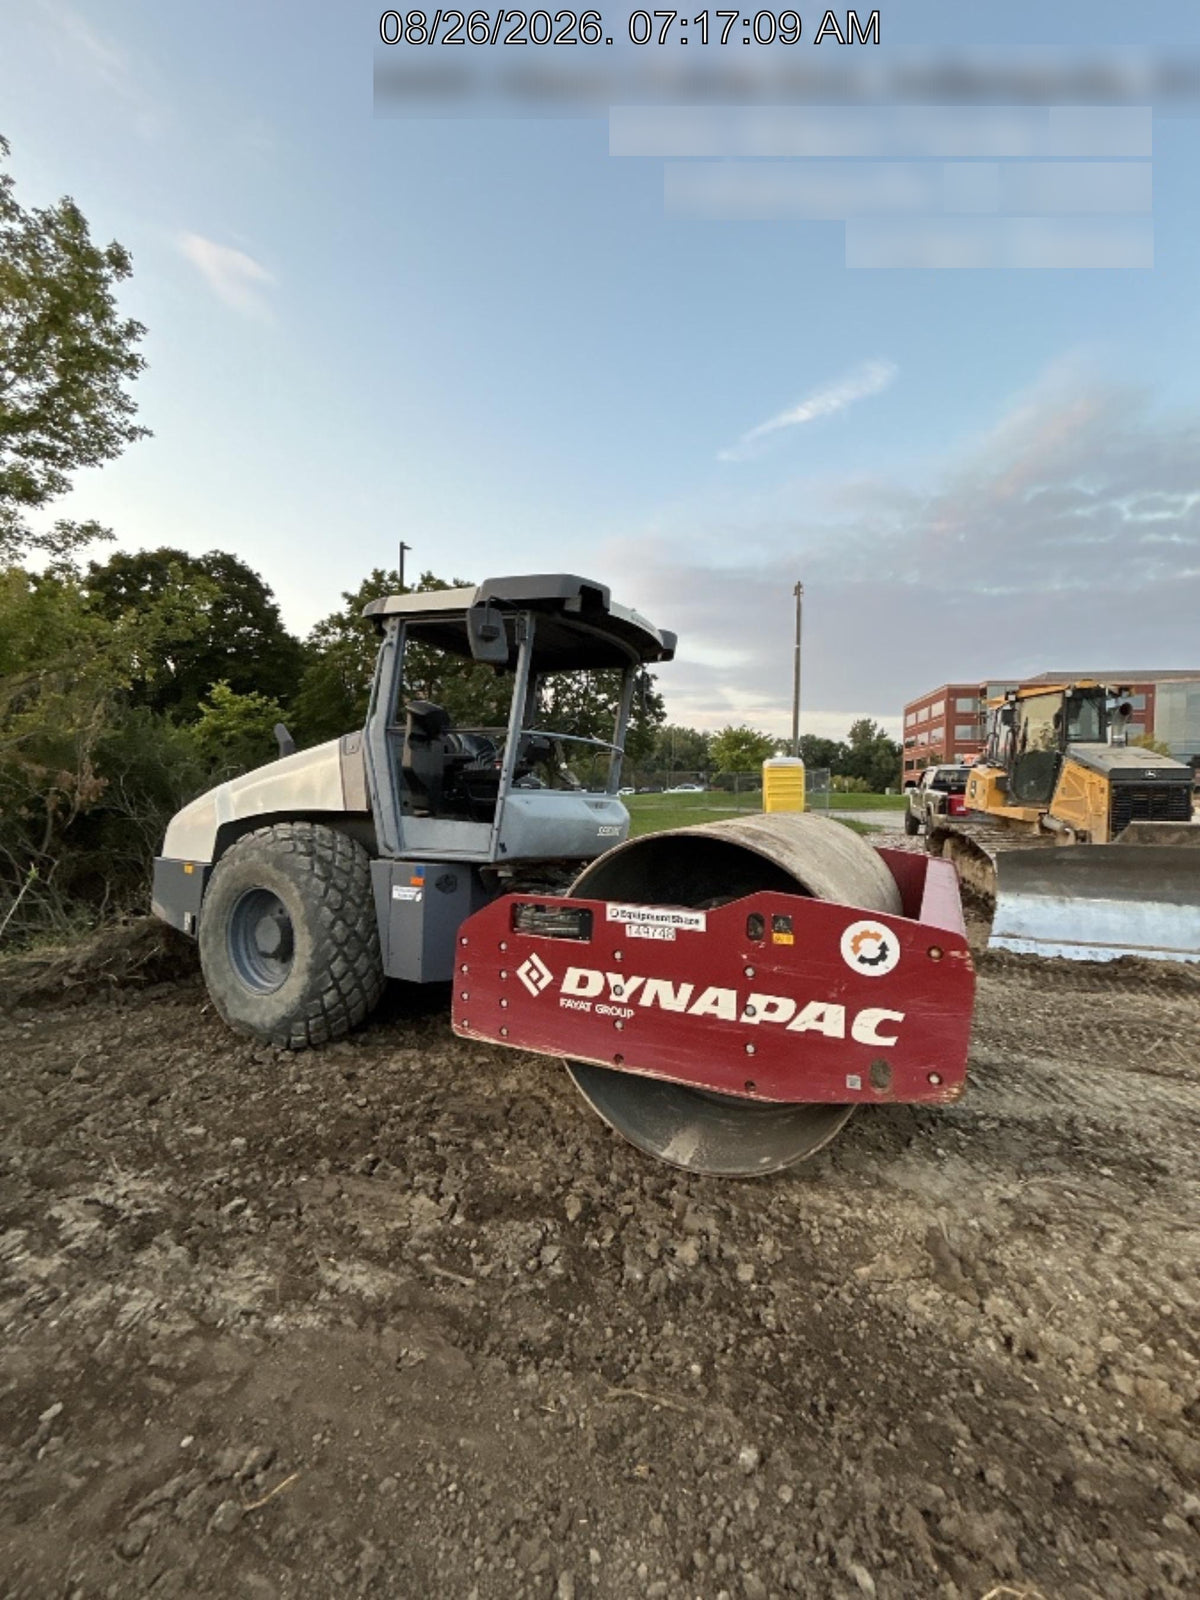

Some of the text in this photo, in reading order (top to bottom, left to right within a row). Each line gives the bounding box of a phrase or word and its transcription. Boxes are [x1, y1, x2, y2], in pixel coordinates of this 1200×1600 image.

[620, 909, 700, 925] EquipmentShare
[559, 966, 906, 1047] DYNAPAC
[559, 998, 636, 1019] FAYAT GROUP
